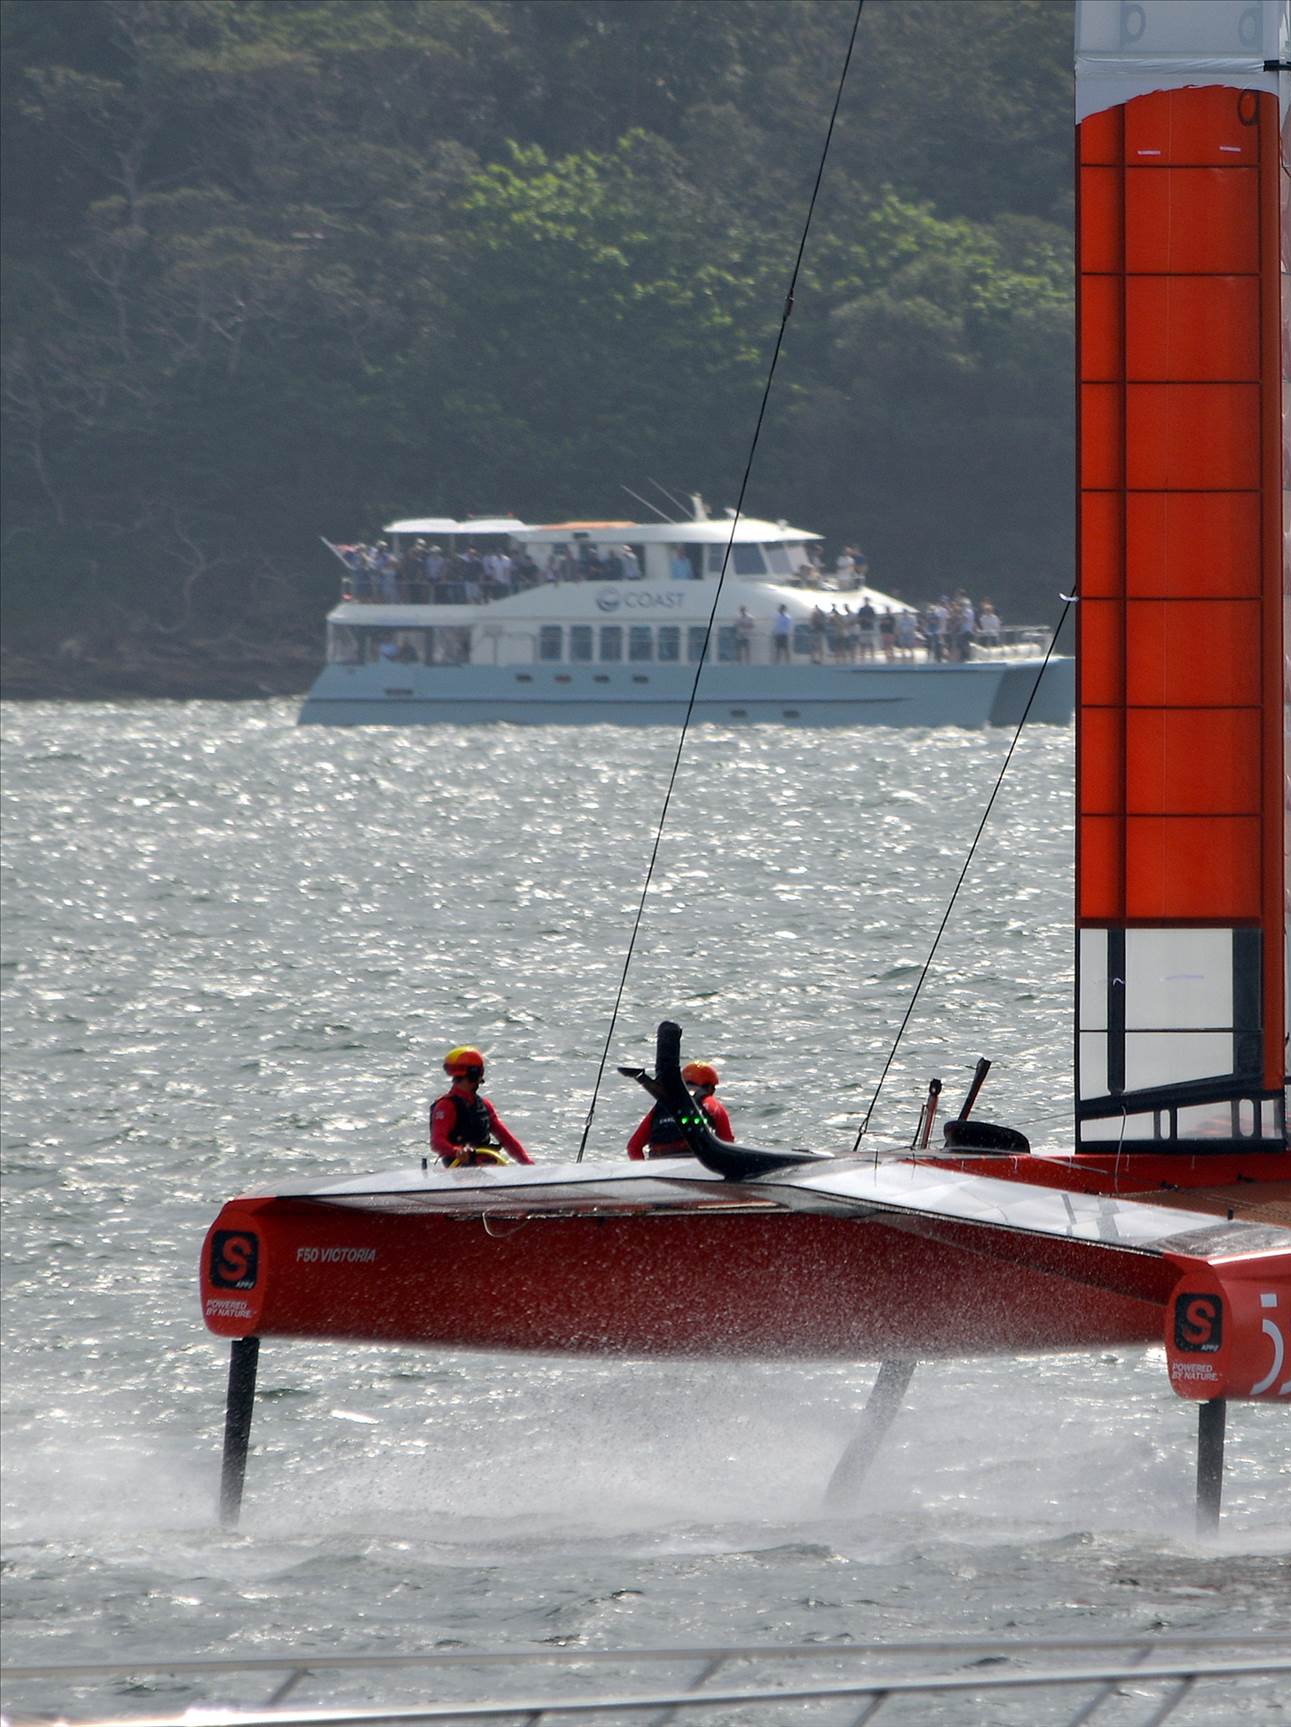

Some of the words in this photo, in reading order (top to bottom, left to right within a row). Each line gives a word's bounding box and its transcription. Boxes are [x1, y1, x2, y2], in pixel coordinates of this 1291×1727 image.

[624, 591, 686, 609] COAST
[295, 1247, 319, 1263] F50
[320, 1247, 377, 1263] VICTORIA
[1171, 1362, 1213, 1373] POWERED
[1170, 1371, 1183, 1380] BY
